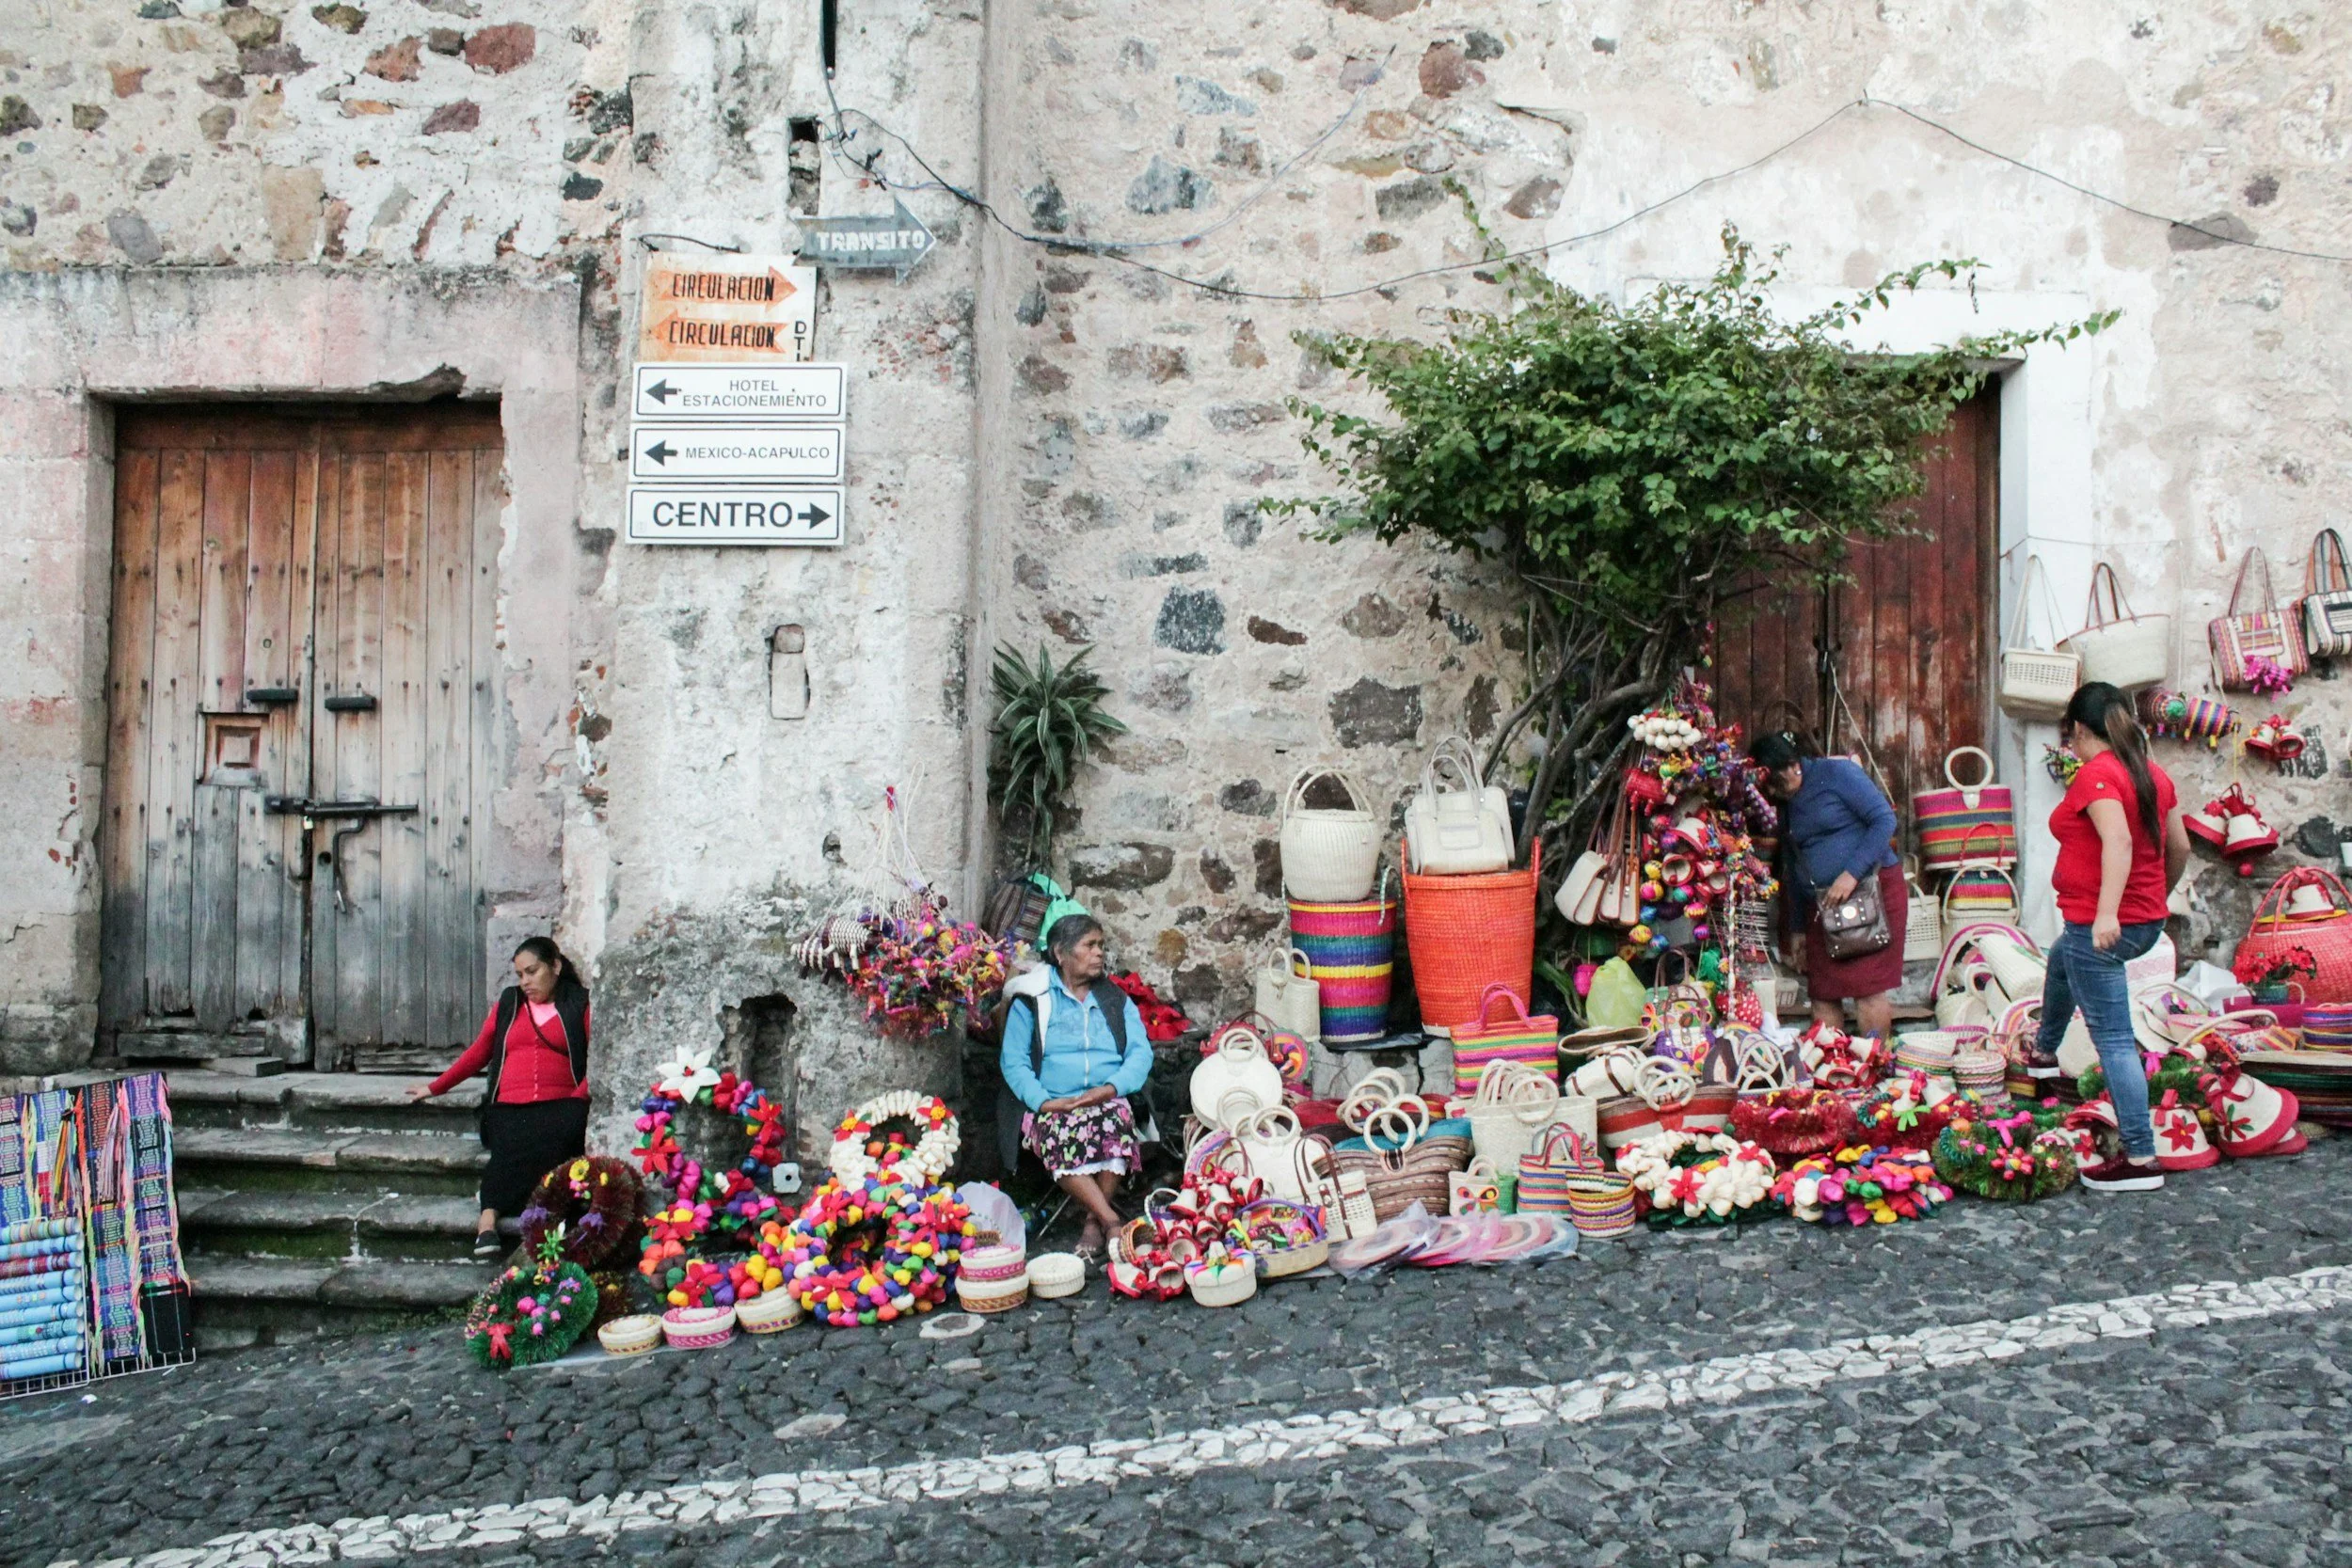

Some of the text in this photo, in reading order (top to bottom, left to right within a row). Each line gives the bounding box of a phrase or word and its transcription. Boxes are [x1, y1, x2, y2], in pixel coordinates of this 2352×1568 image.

[817, 230, 925, 251] TRANSITO
[672, 273, 775, 301] CIRCULACION
[669, 321, 776, 348] CIRCULACION
[729, 379, 780, 392] HOTEL
[682, 394, 827, 407] ESTACIONEMIENTO
[685, 447, 830, 459] MEXICO-ACAPULCO
[653, 501, 793, 528] CENTRO
